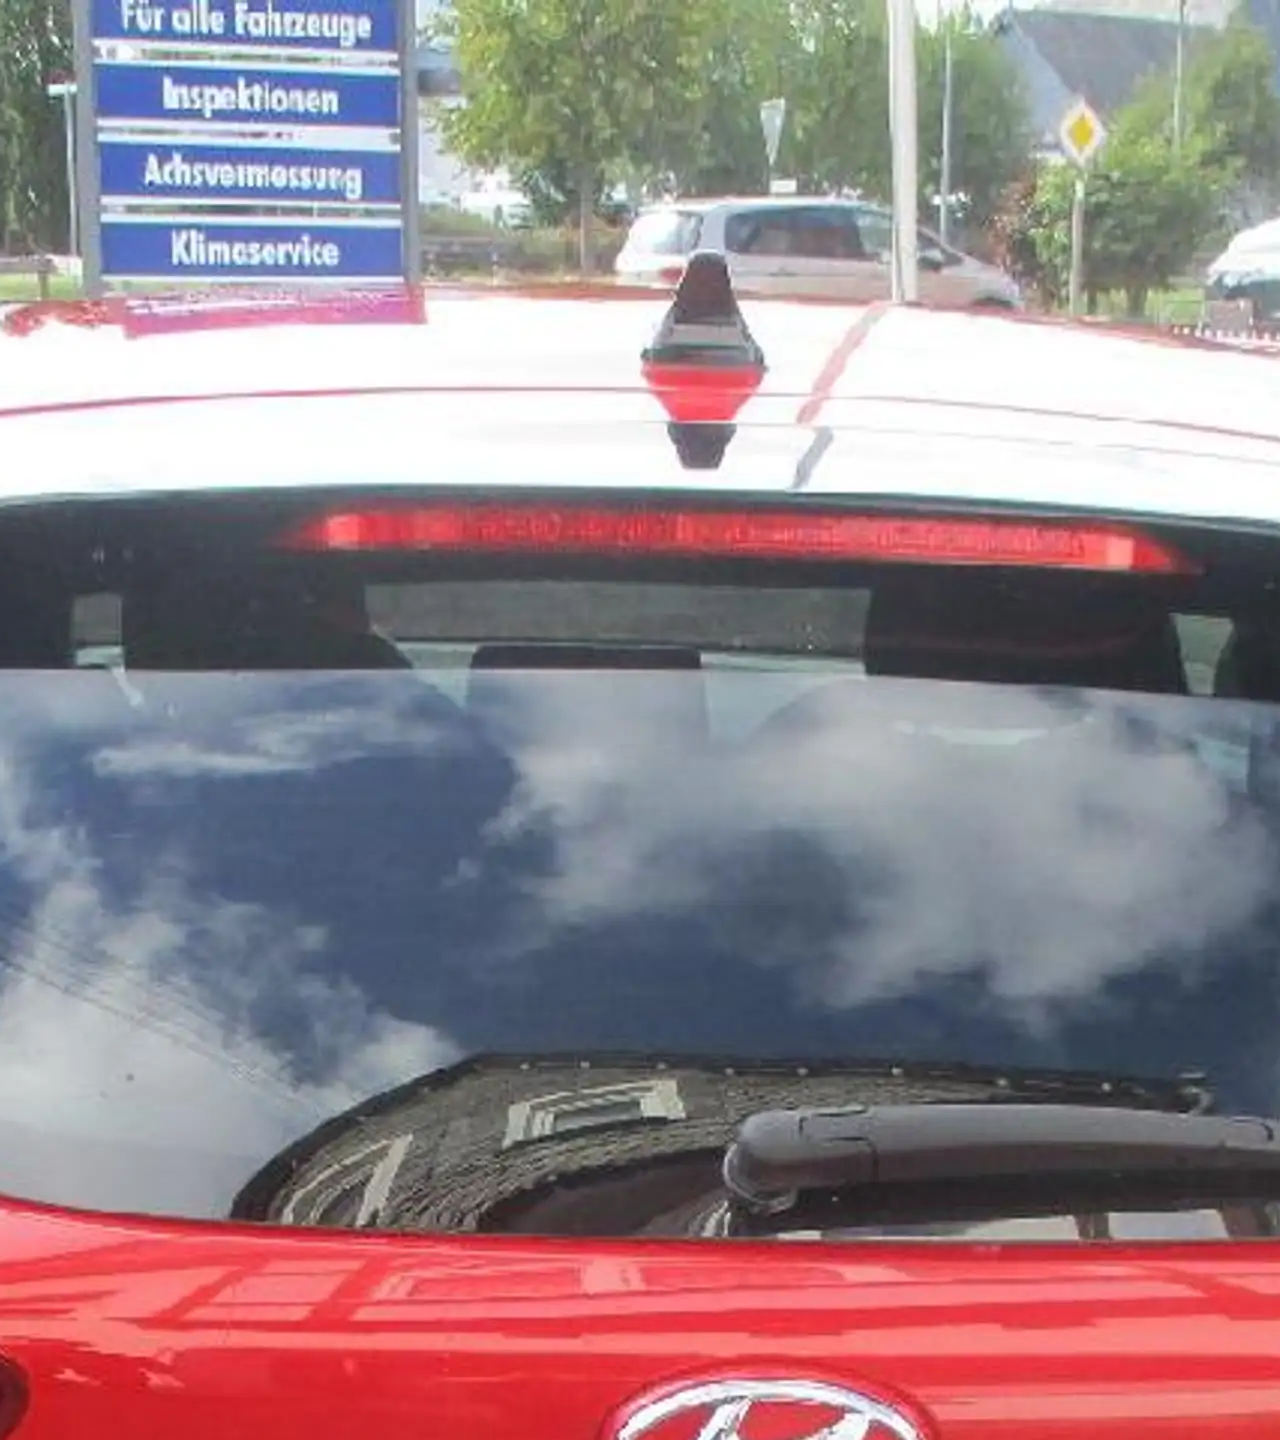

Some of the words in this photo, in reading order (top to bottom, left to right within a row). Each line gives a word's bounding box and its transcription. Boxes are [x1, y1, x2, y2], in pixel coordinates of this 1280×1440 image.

[121, 0, 164, 30] Für
[172, 1, 225, 33] alle
[235, 2, 372, 47] Fahrzeuge
[163, 76, 339, 117] Inspektionen
[144, 152, 362, 199] Achsvermessung
[172, 229, 339, 265] Klimaservice
